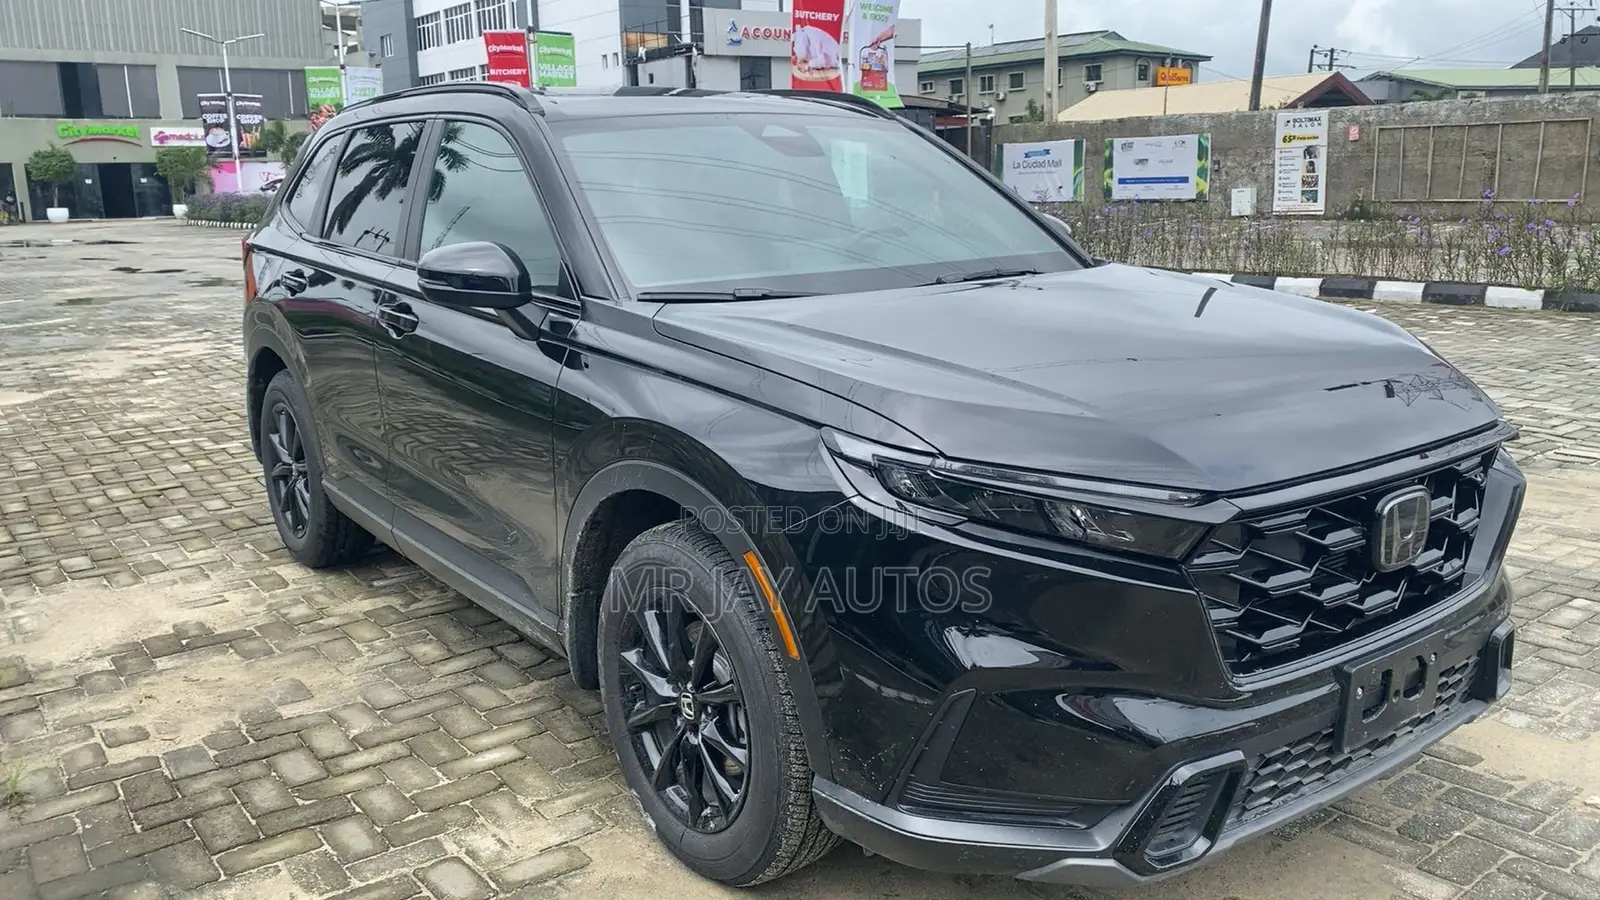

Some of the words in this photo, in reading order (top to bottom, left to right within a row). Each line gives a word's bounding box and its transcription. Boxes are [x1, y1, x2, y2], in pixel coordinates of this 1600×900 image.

[794, 9, 840, 21] BUTCHERY
[1292, 116, 1322, 124] BOLTIMAX
[1012, 160, 1021, 169] La
[1022, 159, 1046, 169] Ciudad
[1047, 158, 1063, 168] Mall
